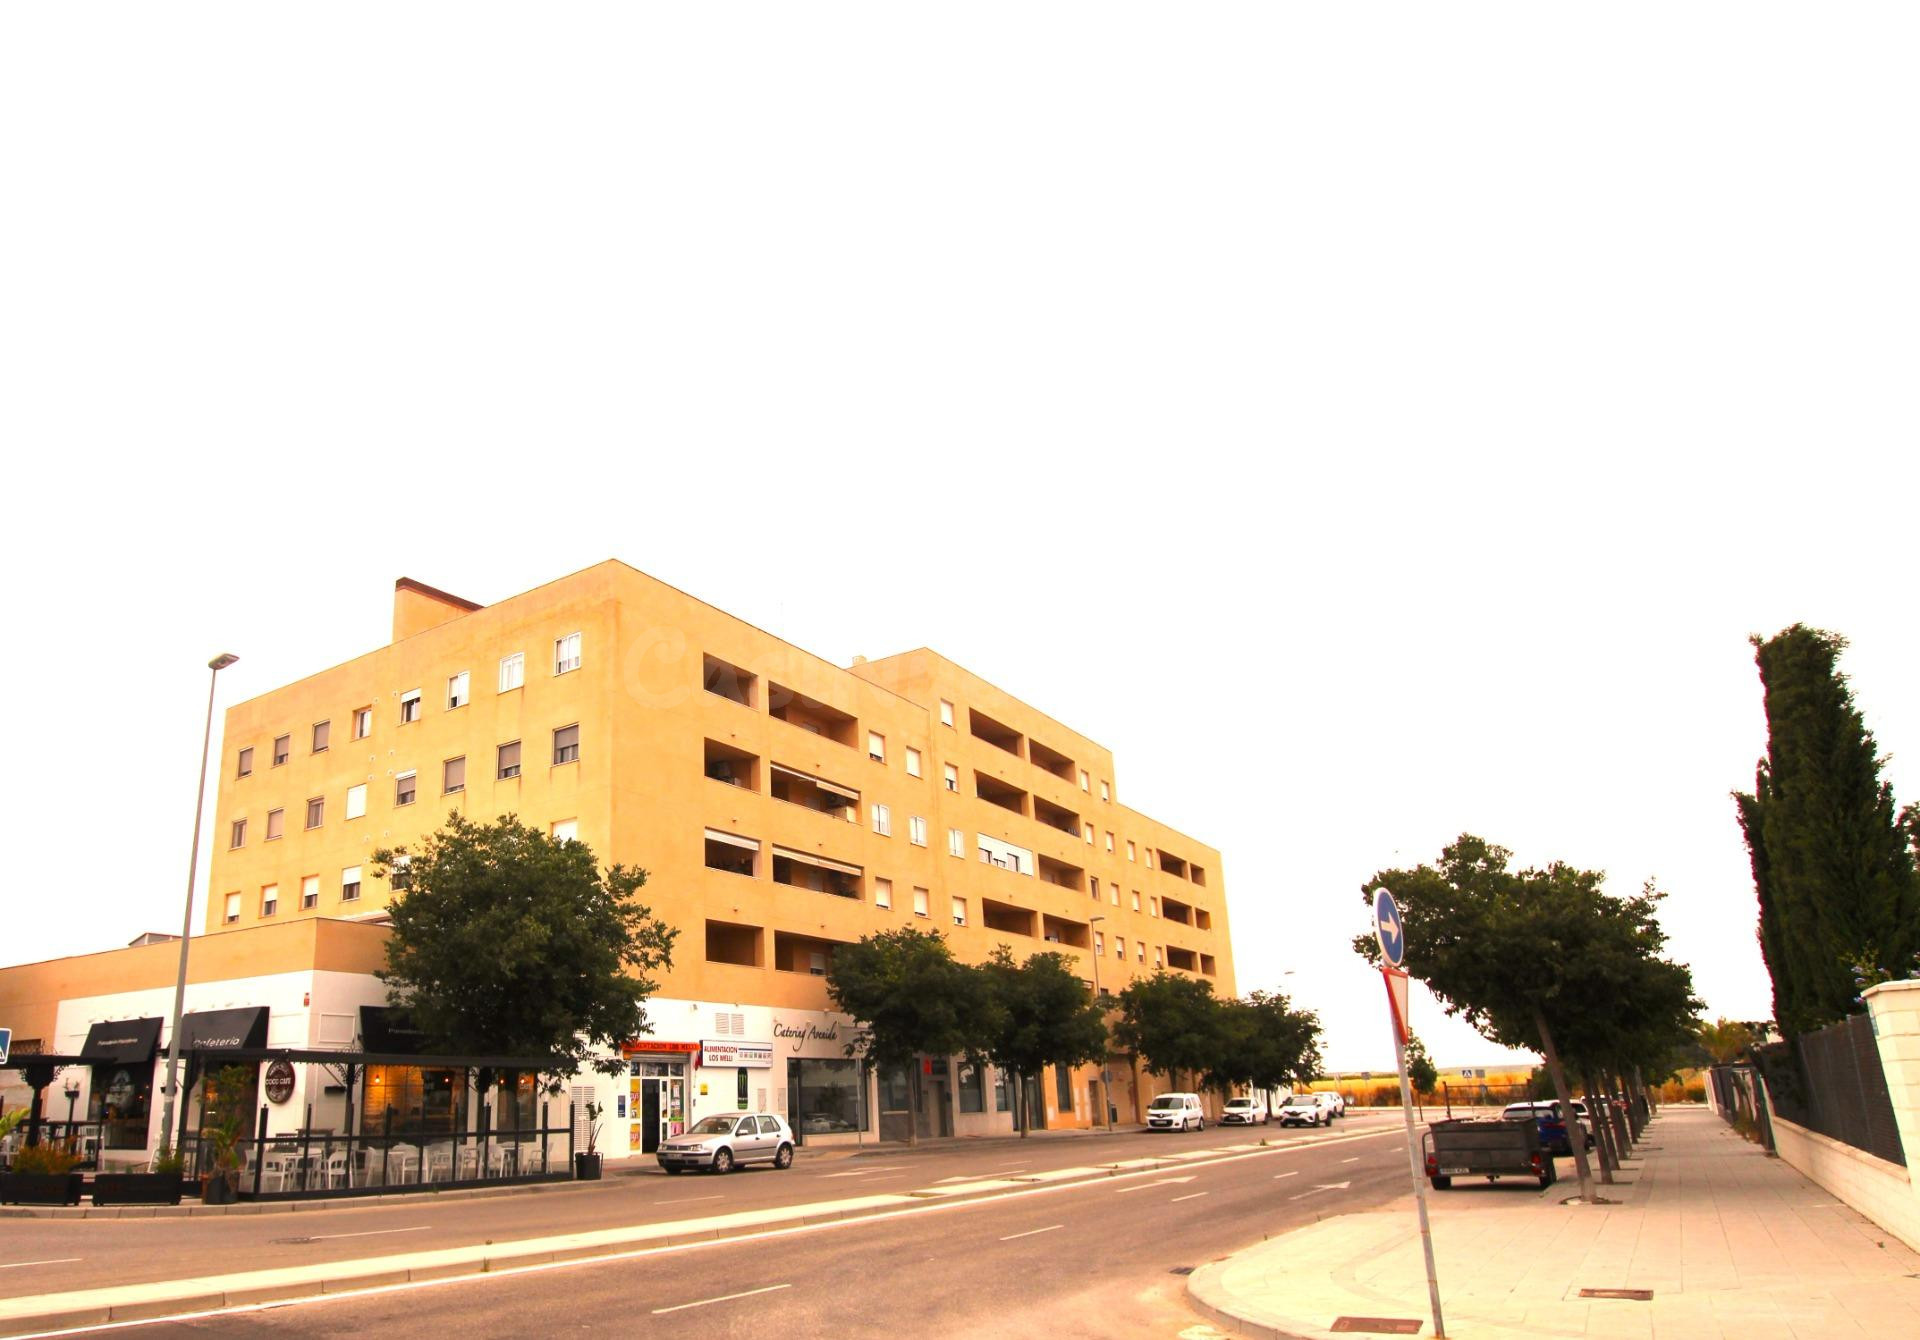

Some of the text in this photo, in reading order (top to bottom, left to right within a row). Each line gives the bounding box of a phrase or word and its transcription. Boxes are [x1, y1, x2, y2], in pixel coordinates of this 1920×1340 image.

[774, 1020, 838, 1052] Catering Avenida
[704, 1045, 738, 1053] ALIMENTACION
[709, 1054, 719, 1062] LOS
